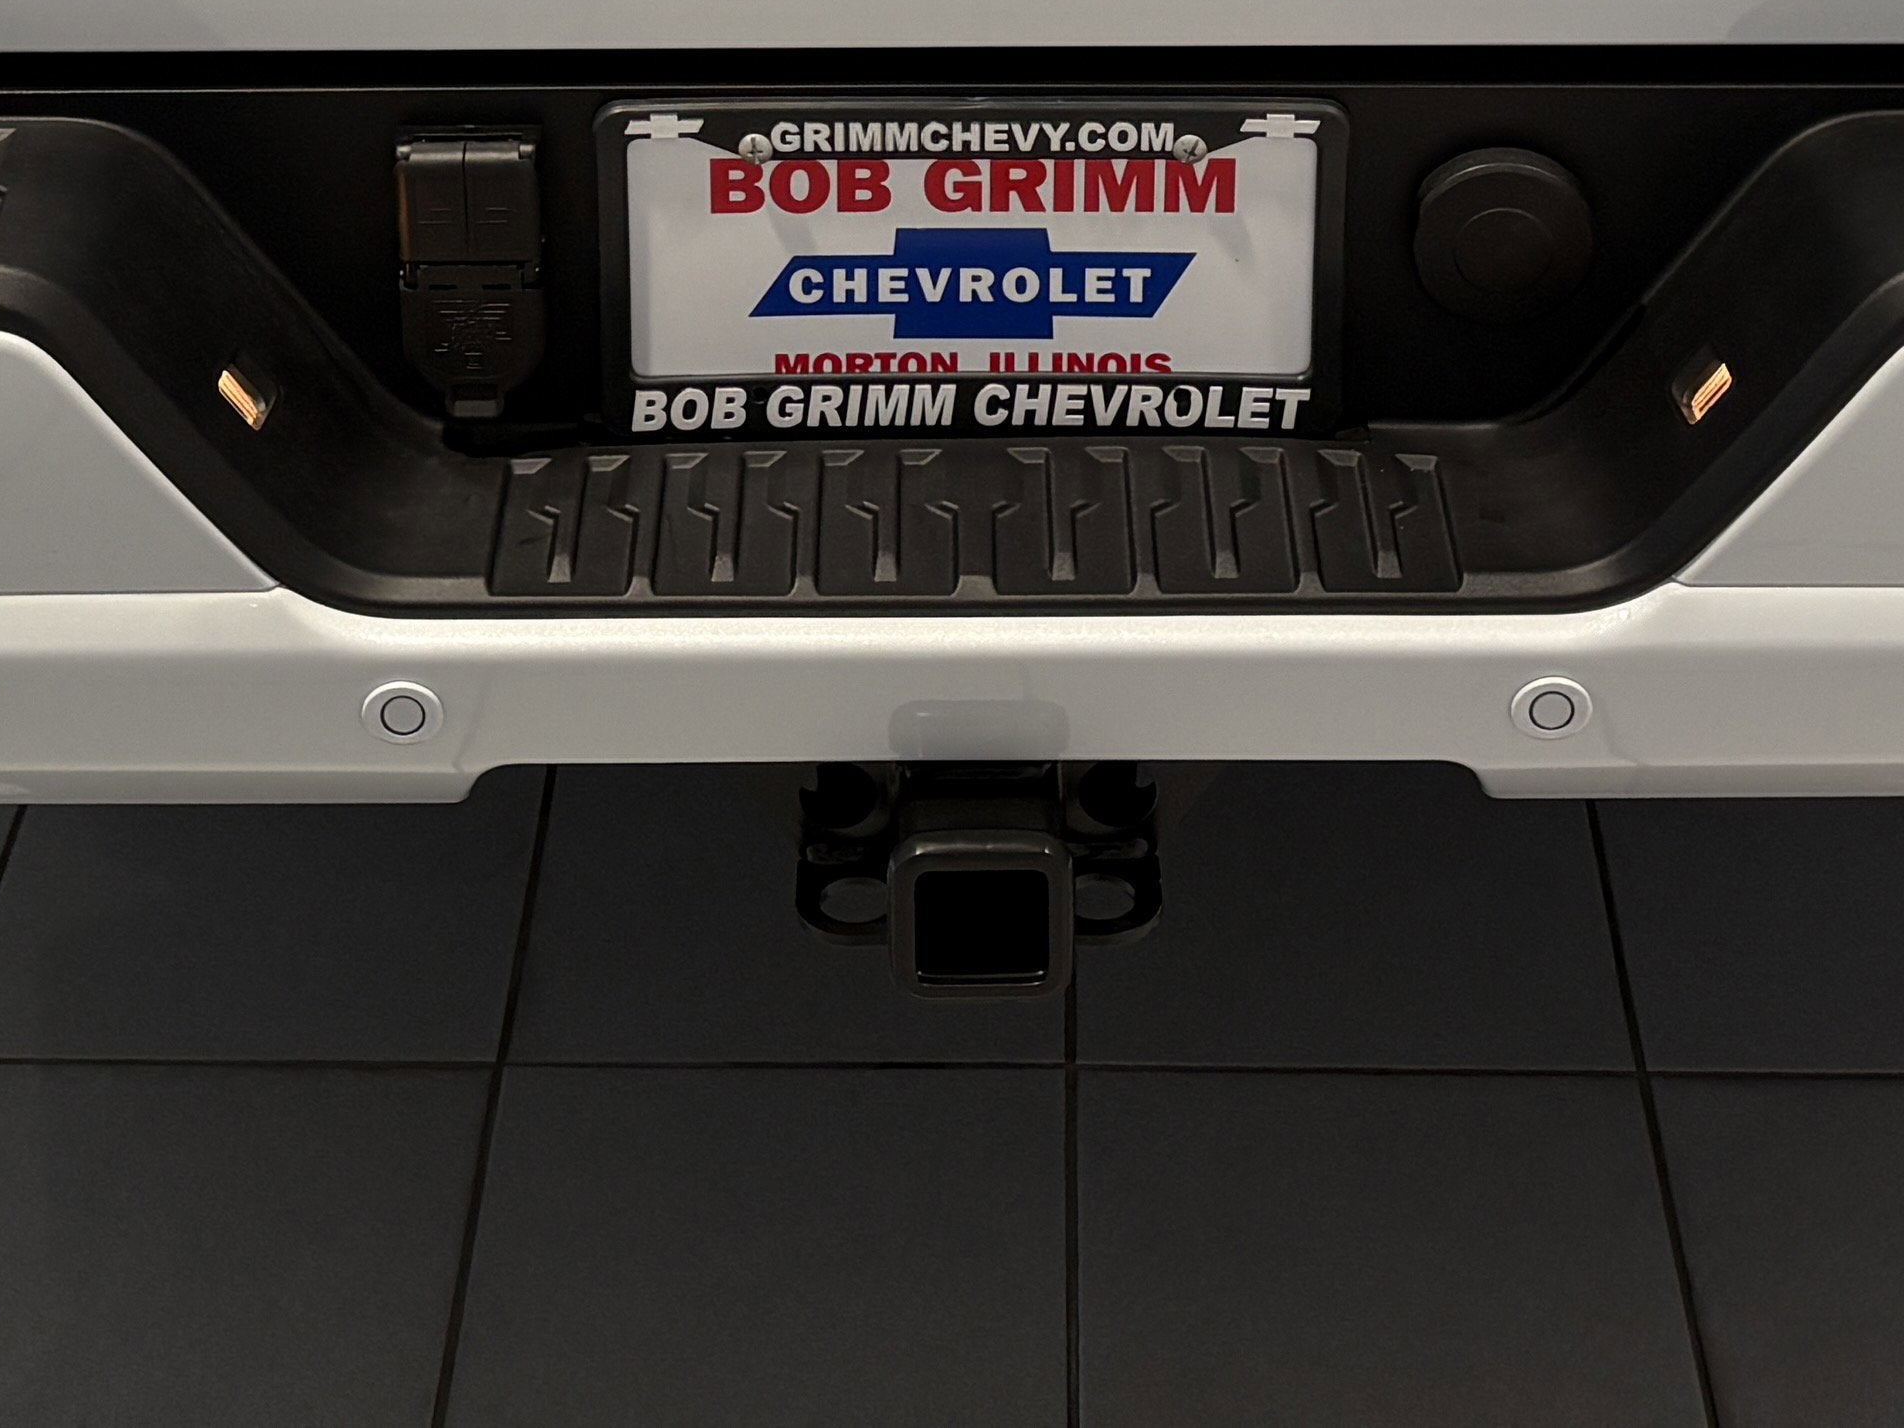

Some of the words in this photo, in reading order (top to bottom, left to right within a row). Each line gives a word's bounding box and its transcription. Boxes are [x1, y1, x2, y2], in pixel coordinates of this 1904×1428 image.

[769, 120, 1175, 154] GRIMMCHEVY.COM
[709, 158, 893, 215] BOB
[925, 158, 1236, 215] GRIMM
[788, 267, 1152, 304] CHEVROLET
[632, 387, 747, 433] BOB
[766, 385, 958, 429] GRIMM
[974, 384, 1311, 430] CHEVROLET
